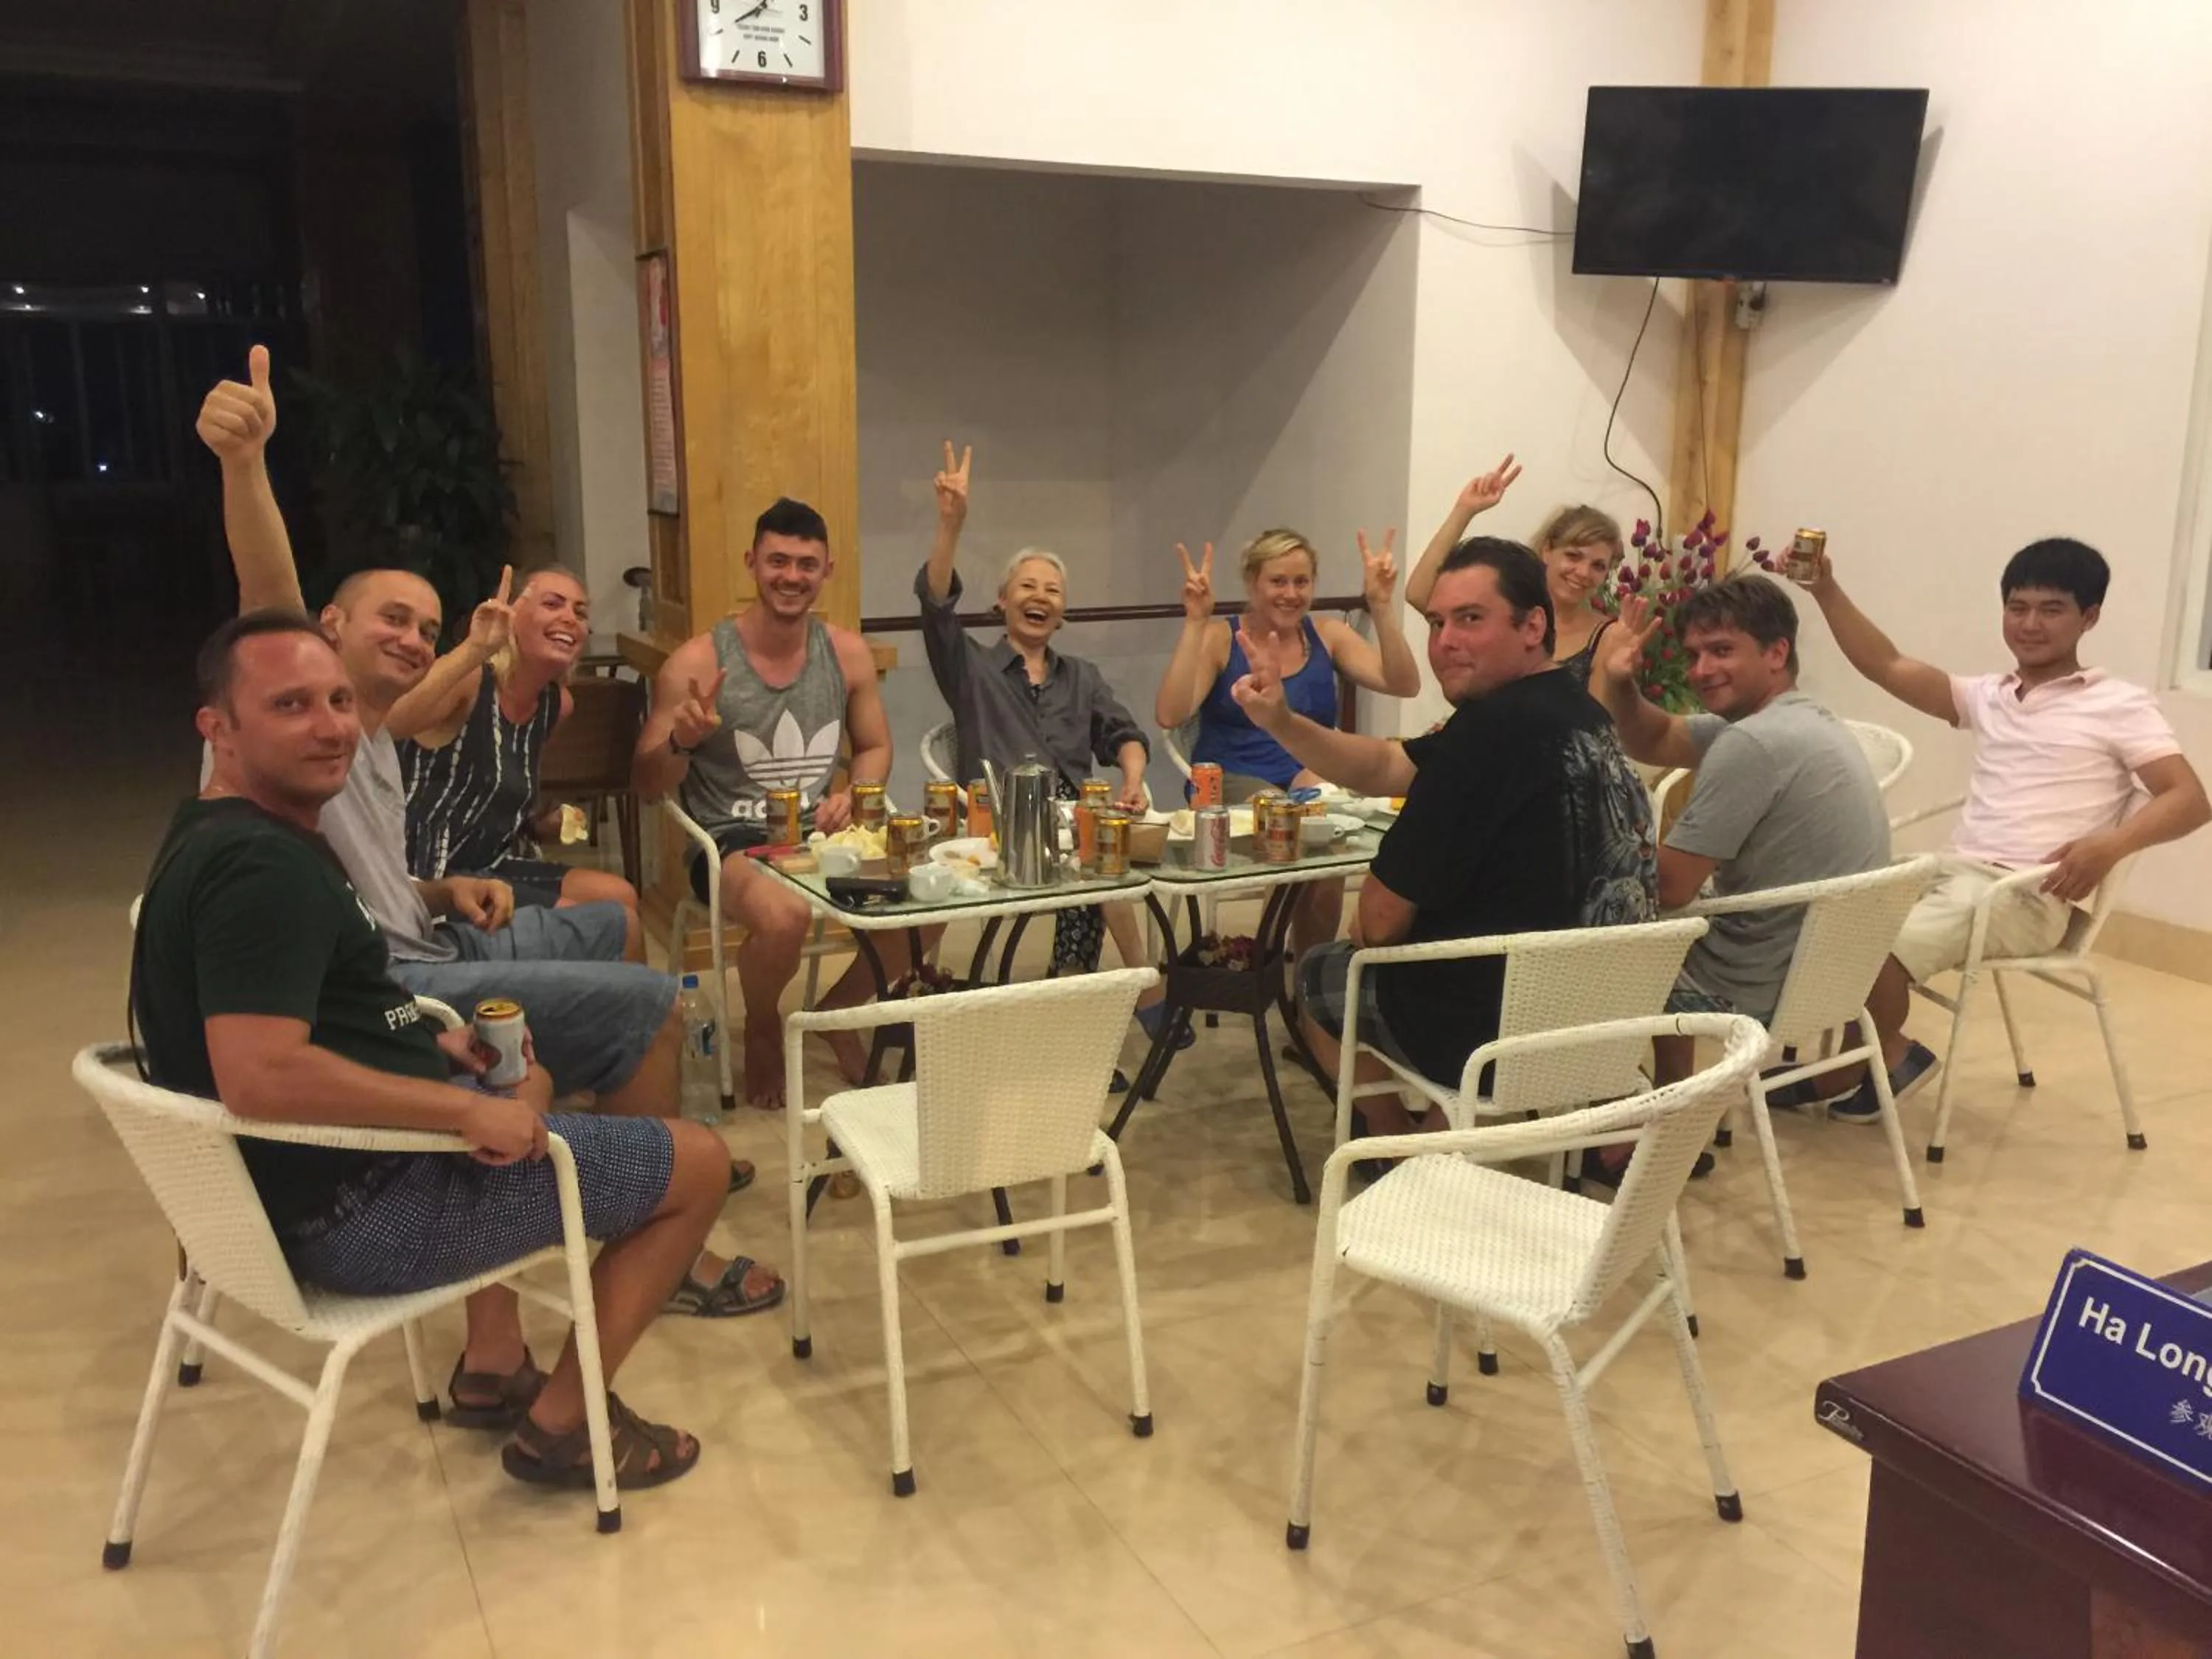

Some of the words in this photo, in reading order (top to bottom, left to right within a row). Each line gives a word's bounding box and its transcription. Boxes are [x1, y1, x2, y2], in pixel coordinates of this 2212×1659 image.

[710, 0, 720, 13] 9
[799, 4, 808, 21] 3
[757, 50, 767, 68] 6
[2079, 1296, 2126, 1345] Ha
